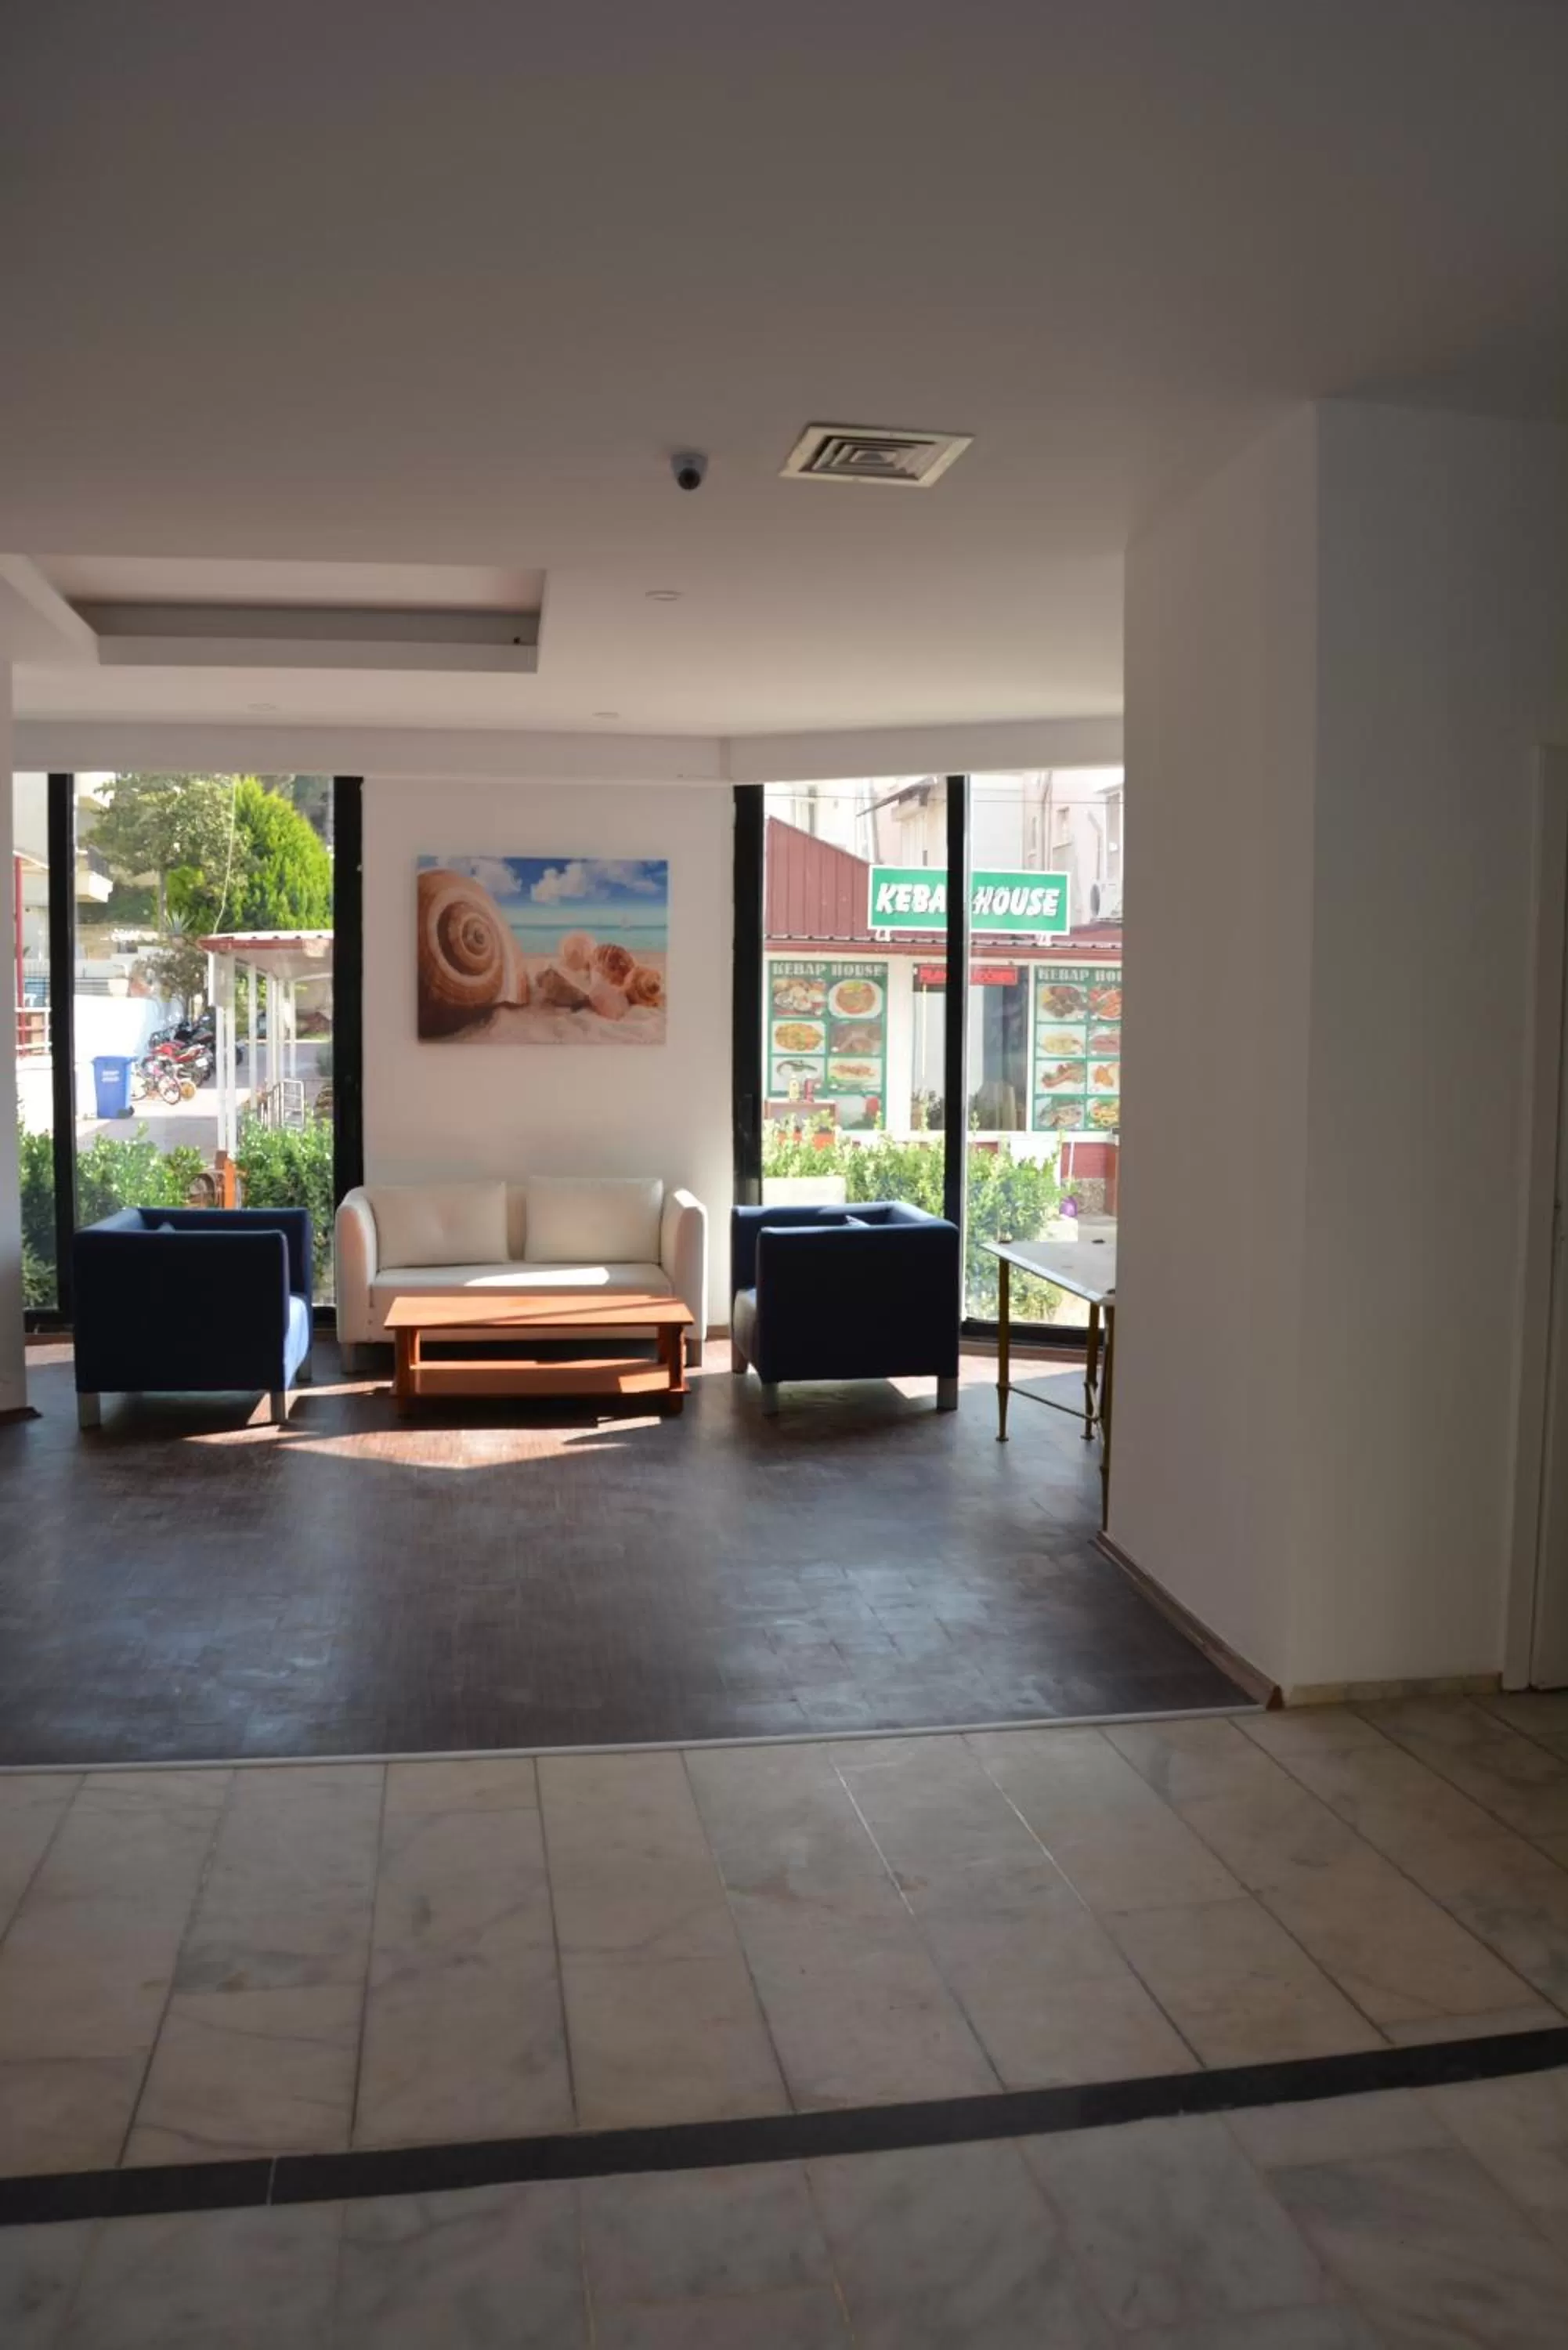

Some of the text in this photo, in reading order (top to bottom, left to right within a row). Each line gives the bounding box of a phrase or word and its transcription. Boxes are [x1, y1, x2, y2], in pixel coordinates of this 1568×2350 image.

[876, 883, 1060, 916] KEBA HOUSE
[773, 962, 883, 977] KEBAP HOUSE
[1039, 968, 1089, 981] KEBAP
